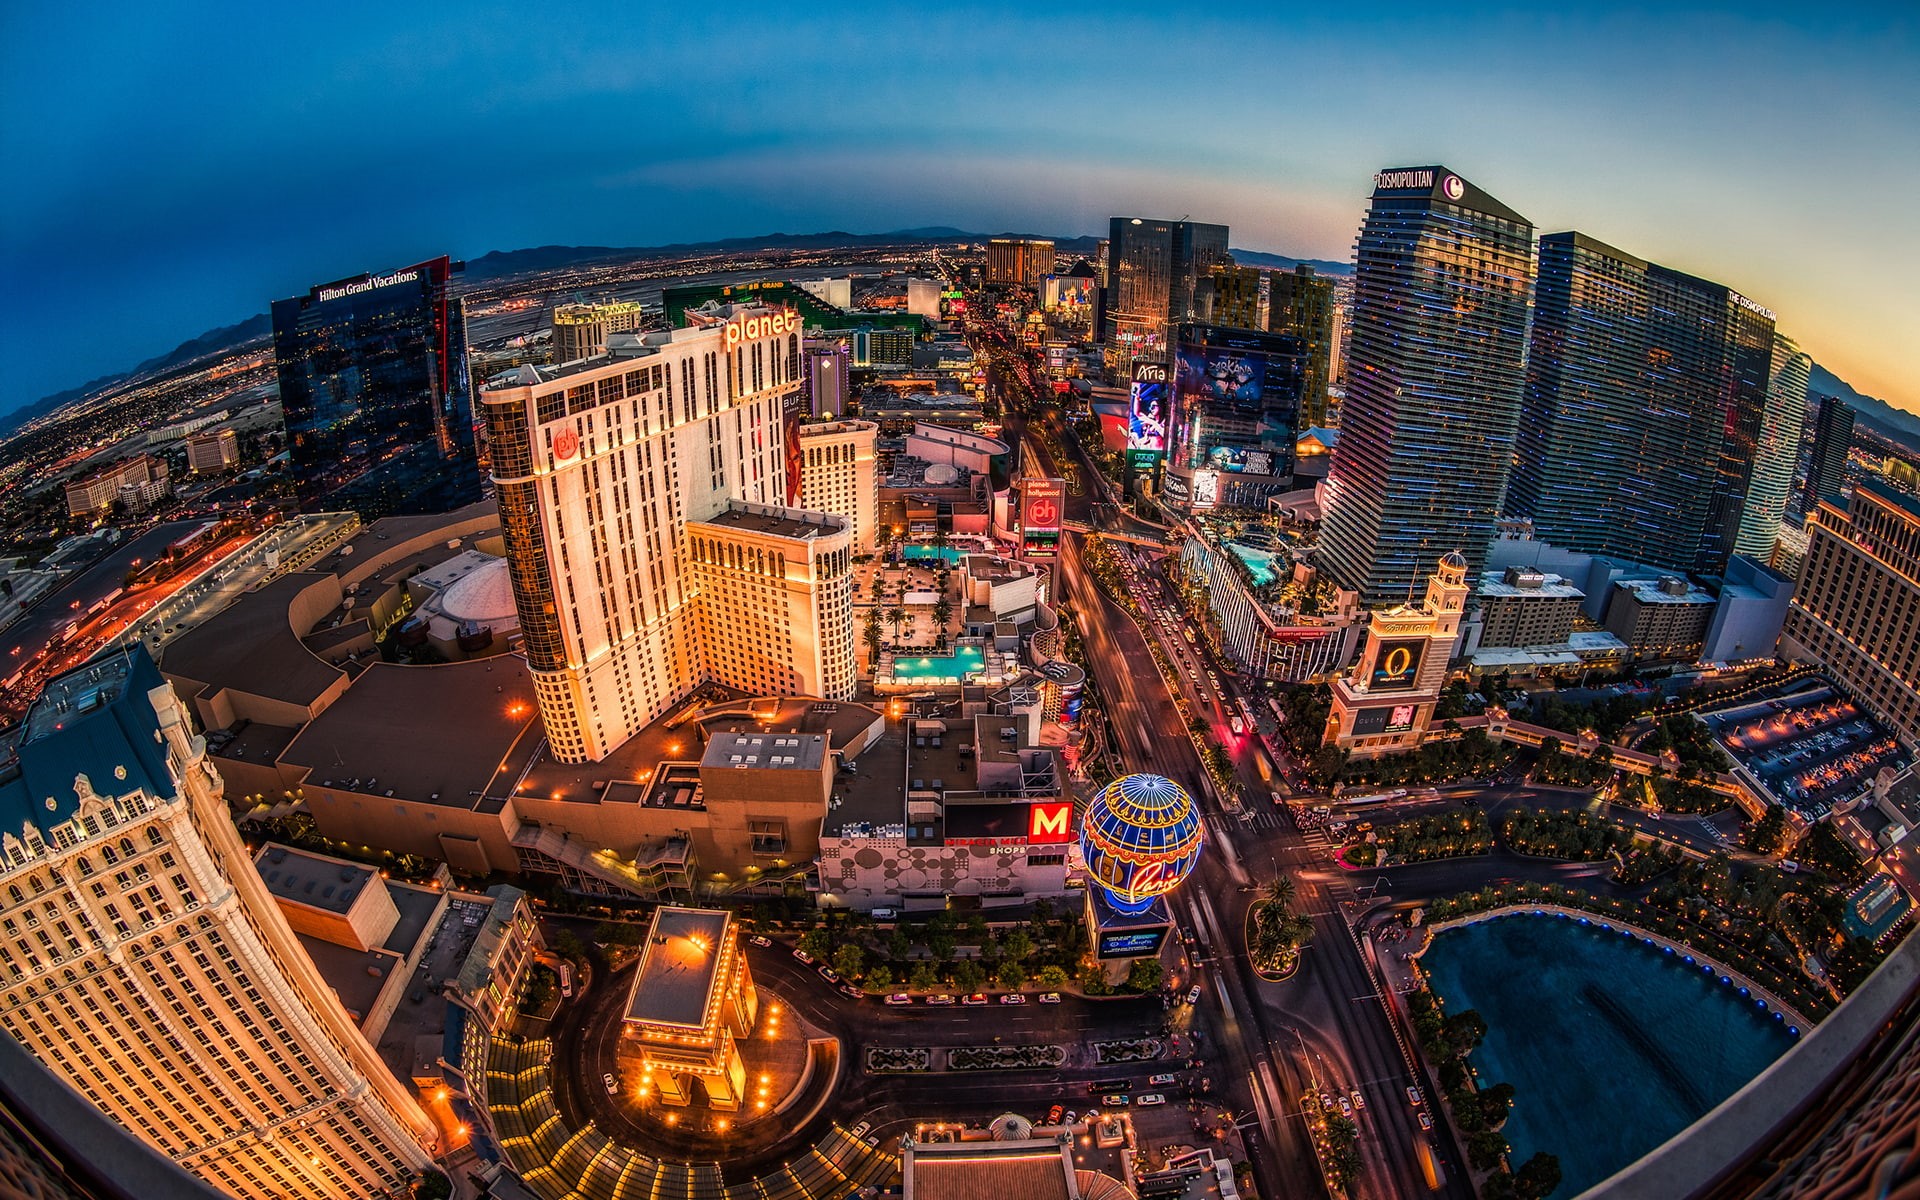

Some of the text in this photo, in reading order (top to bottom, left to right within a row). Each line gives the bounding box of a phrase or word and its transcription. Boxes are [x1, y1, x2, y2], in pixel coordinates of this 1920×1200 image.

[1378, 170, 1433, 188] COSMOPOLITAN
[319, 271, 418, 302] Hilton Grand Vacations
[1728, 290, 1777, 322] THE COSMOPOLITAN
[727, 308, 795, 353] planet
[1136, 364, 1166, 381] Aria
[1028, 489, 1060, 497] hollywood
[1033, 807, 1069, 835] M
[945, 837, 1026, 846] MIRACLE MILE
[1130, 861, 1179, 904] Paris
